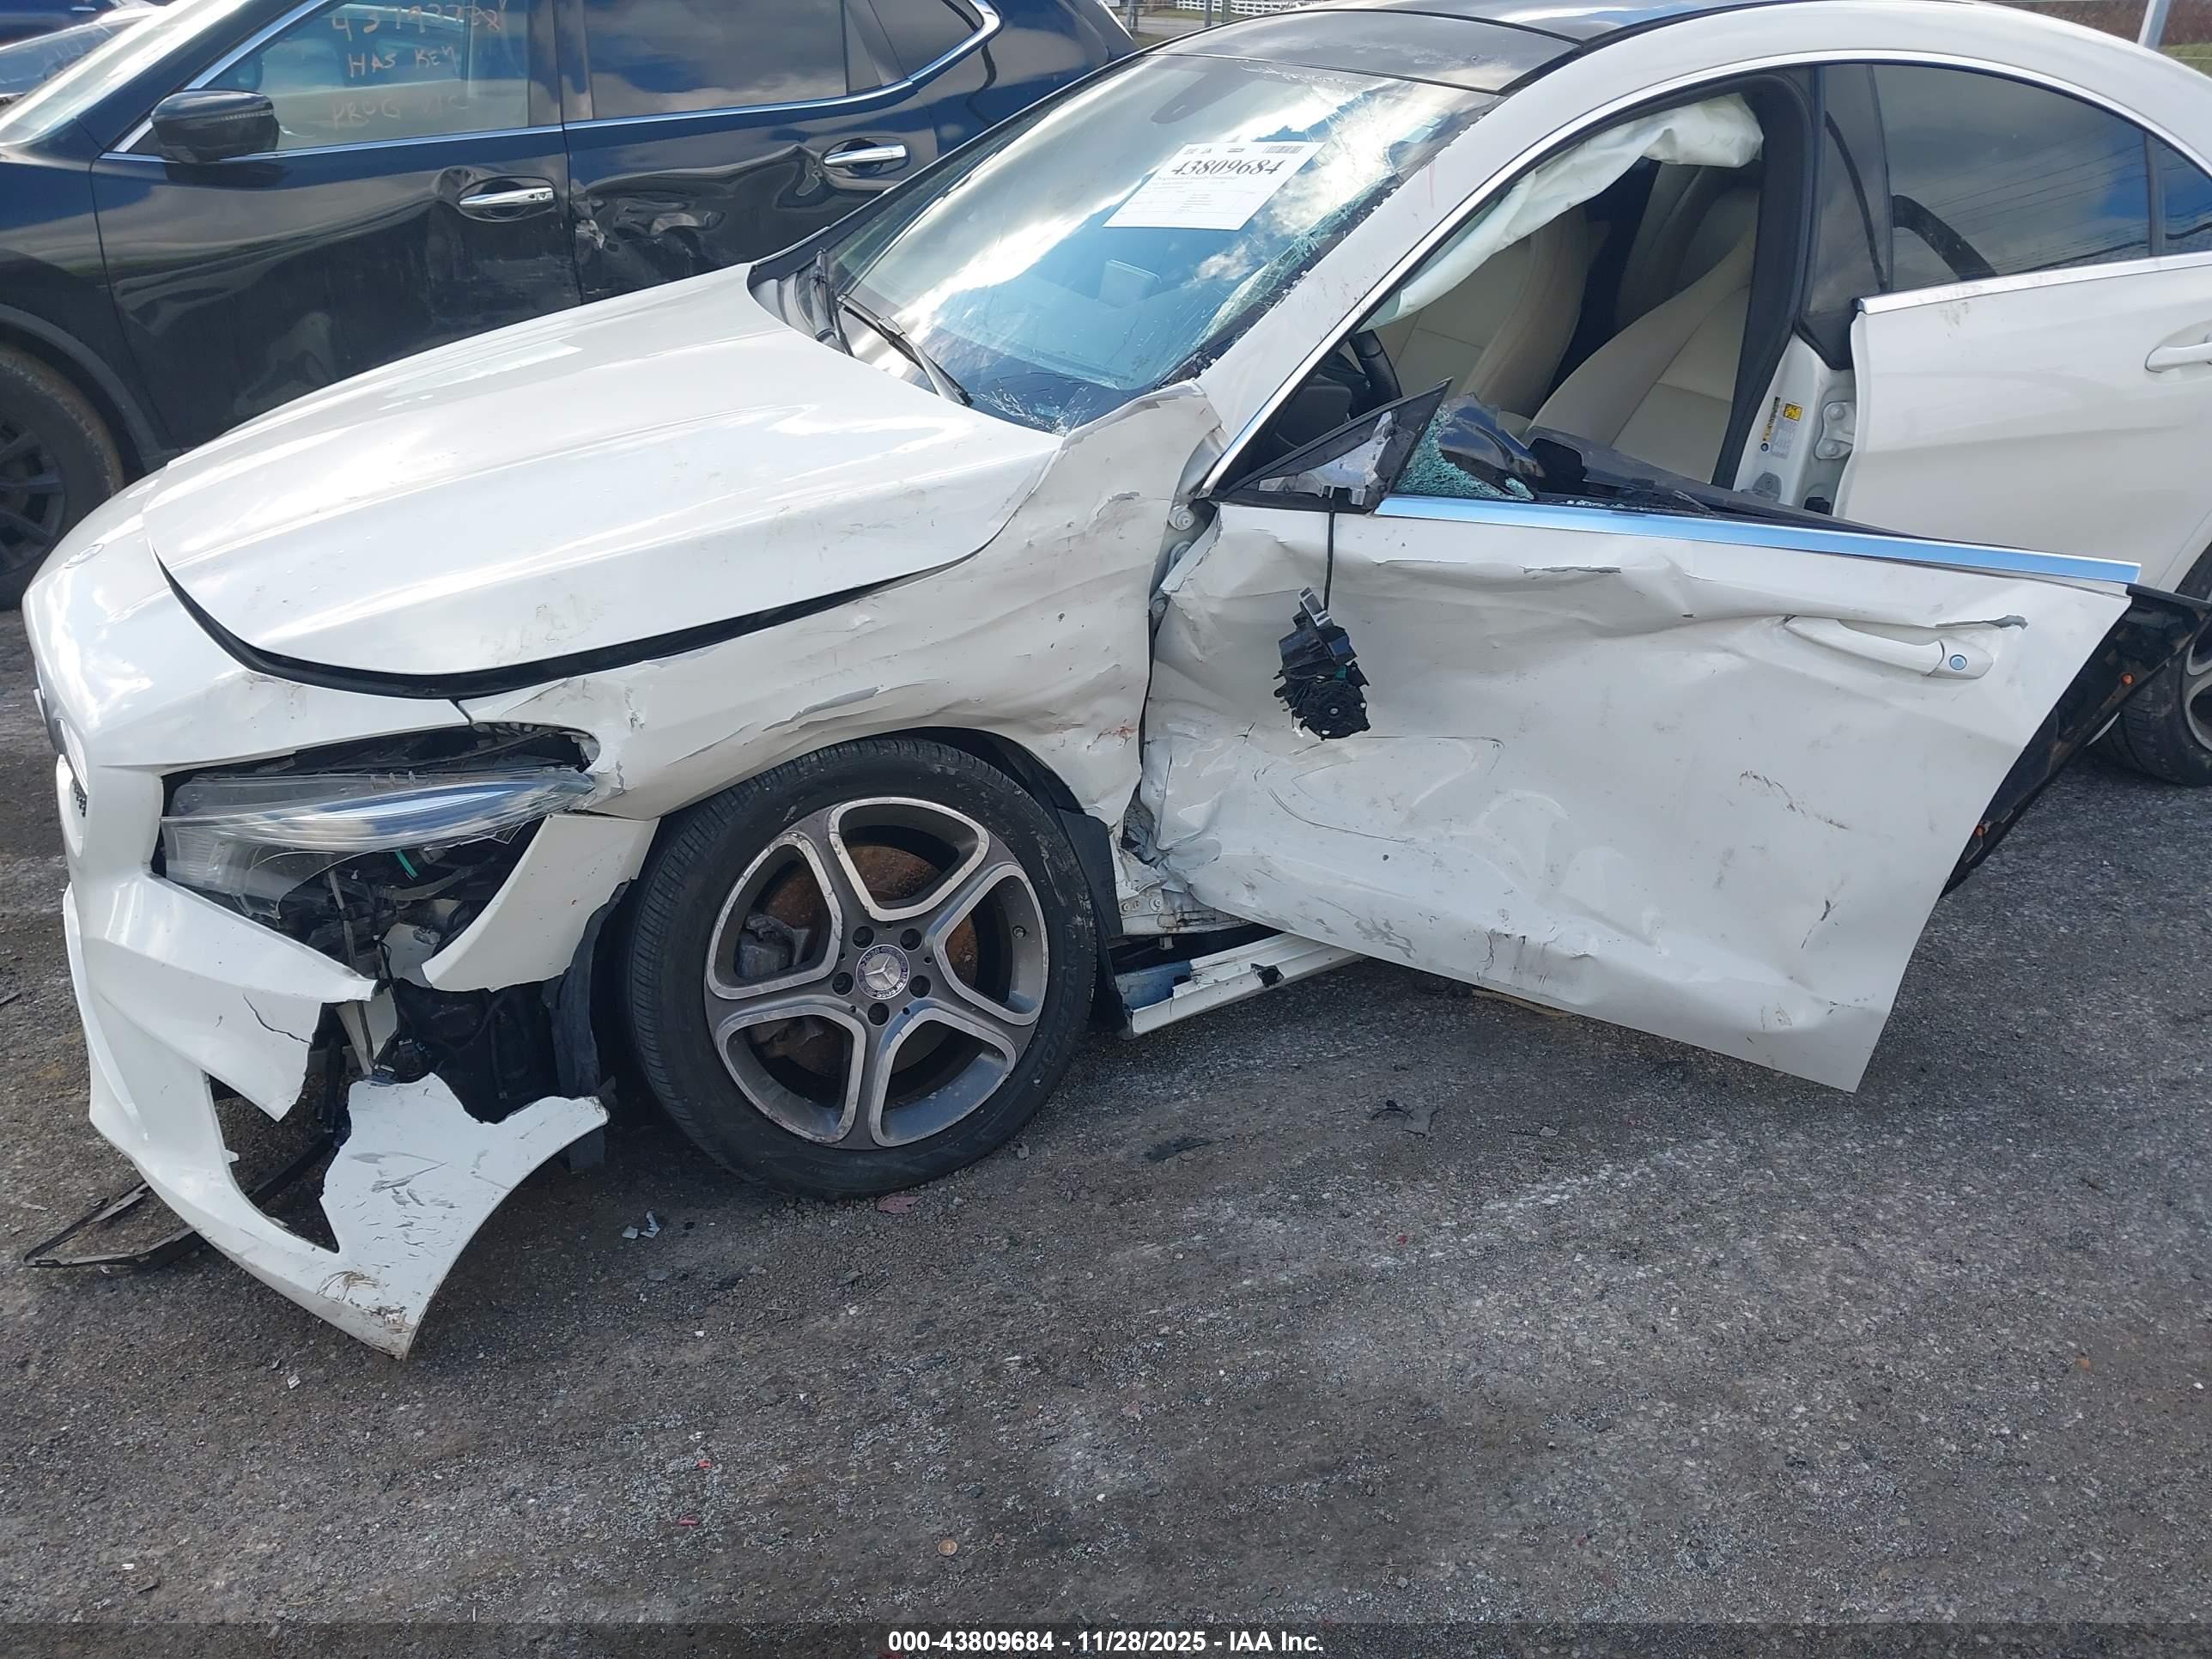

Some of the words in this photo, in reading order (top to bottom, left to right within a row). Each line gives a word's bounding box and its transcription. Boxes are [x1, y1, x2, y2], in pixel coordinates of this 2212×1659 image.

[348, 52, 398, 79] HAS
[415, 46, 459, 76] KEY
[1171, 159, 1285, 175] 43809684
